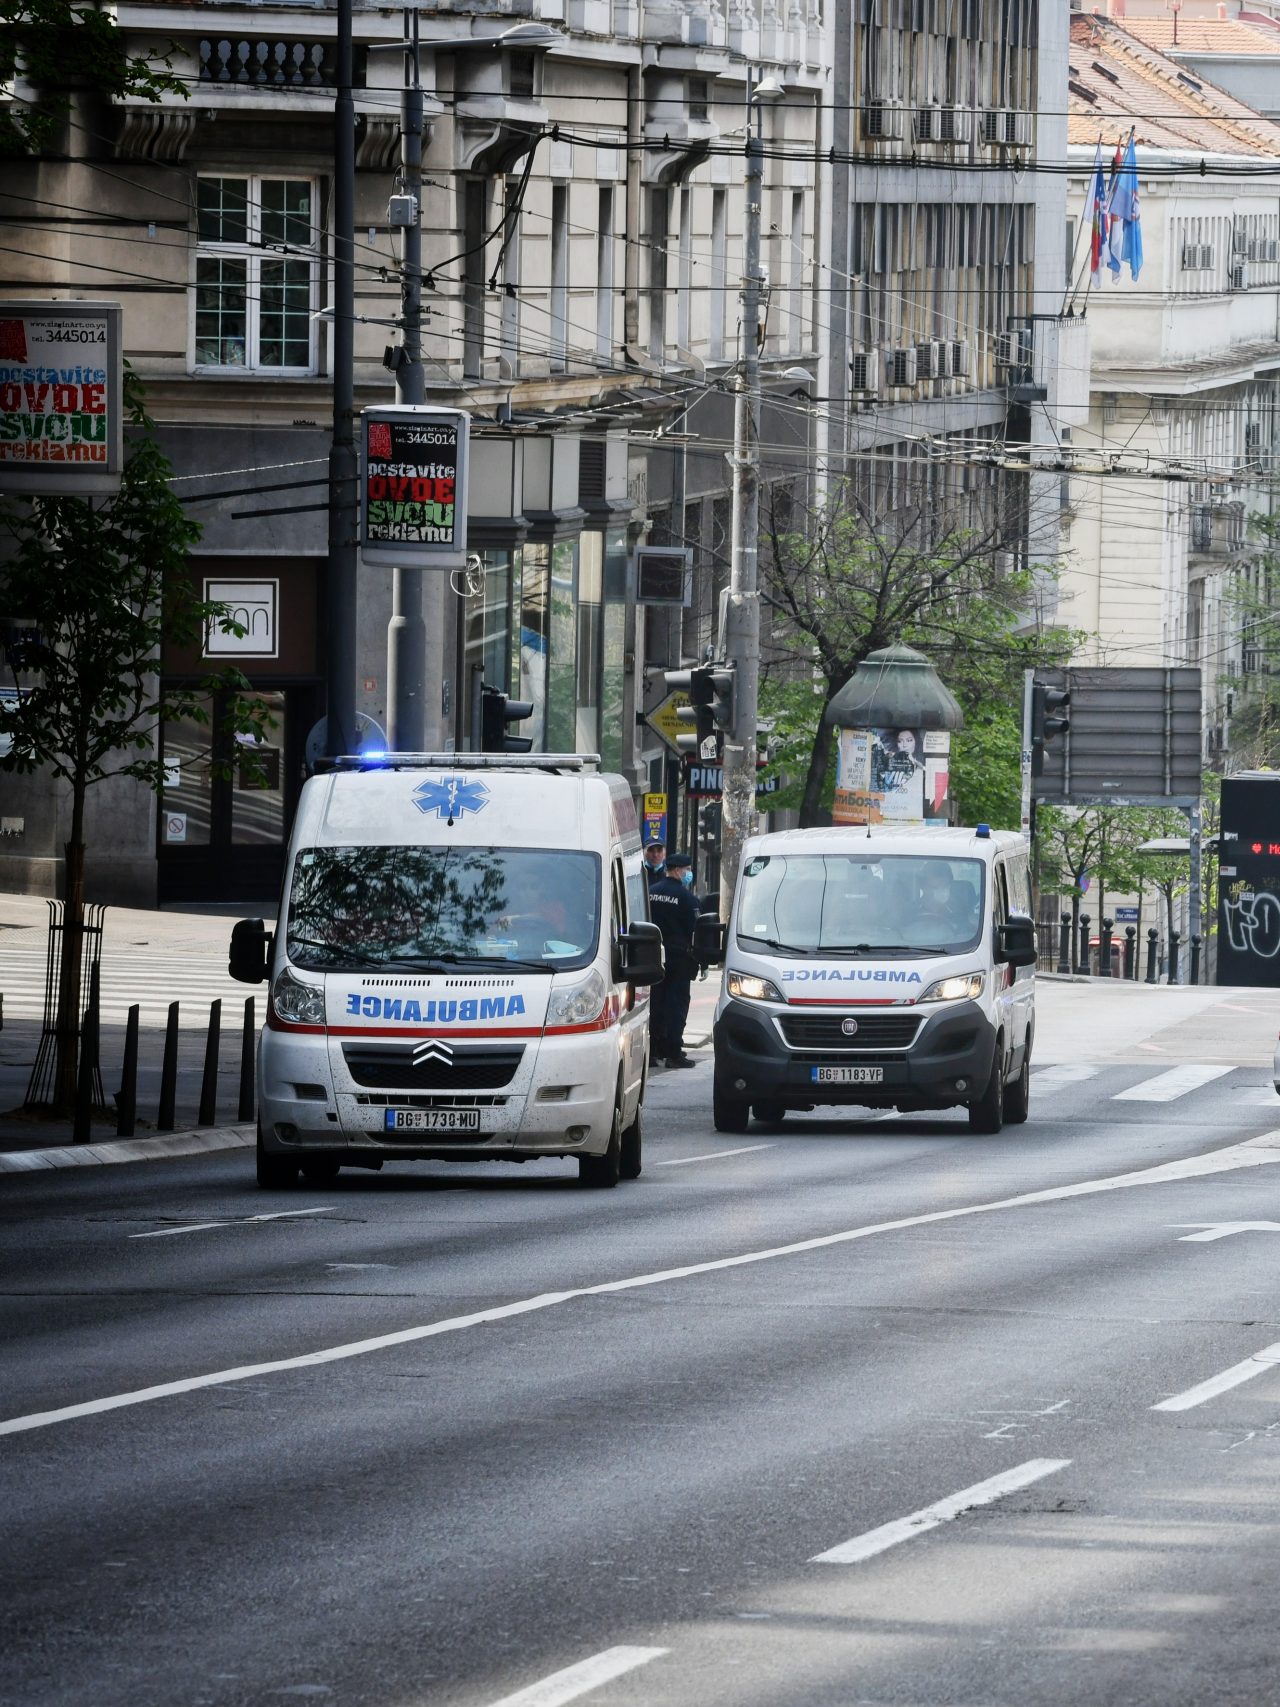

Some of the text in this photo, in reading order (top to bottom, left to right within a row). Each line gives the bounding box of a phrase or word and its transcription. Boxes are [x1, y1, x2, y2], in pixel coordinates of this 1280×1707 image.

[46, 330, 106, 343] 3445014
[0, 383, 105, 414] OVDE
[0, 411, 106, 443] svoju
[407, 433, 456, 445] 3445014
[0, 440, 106, 461] reklamu
[368, 462, 455, 479] postavite
[368, 477, 454, 504] OVDE
[368, 500, 454, 527] svoju
[368, 522, 453, 542] reklamu
[819, 1068, 832, 1080] BG
[397, 1111, 414, 1127] BG
